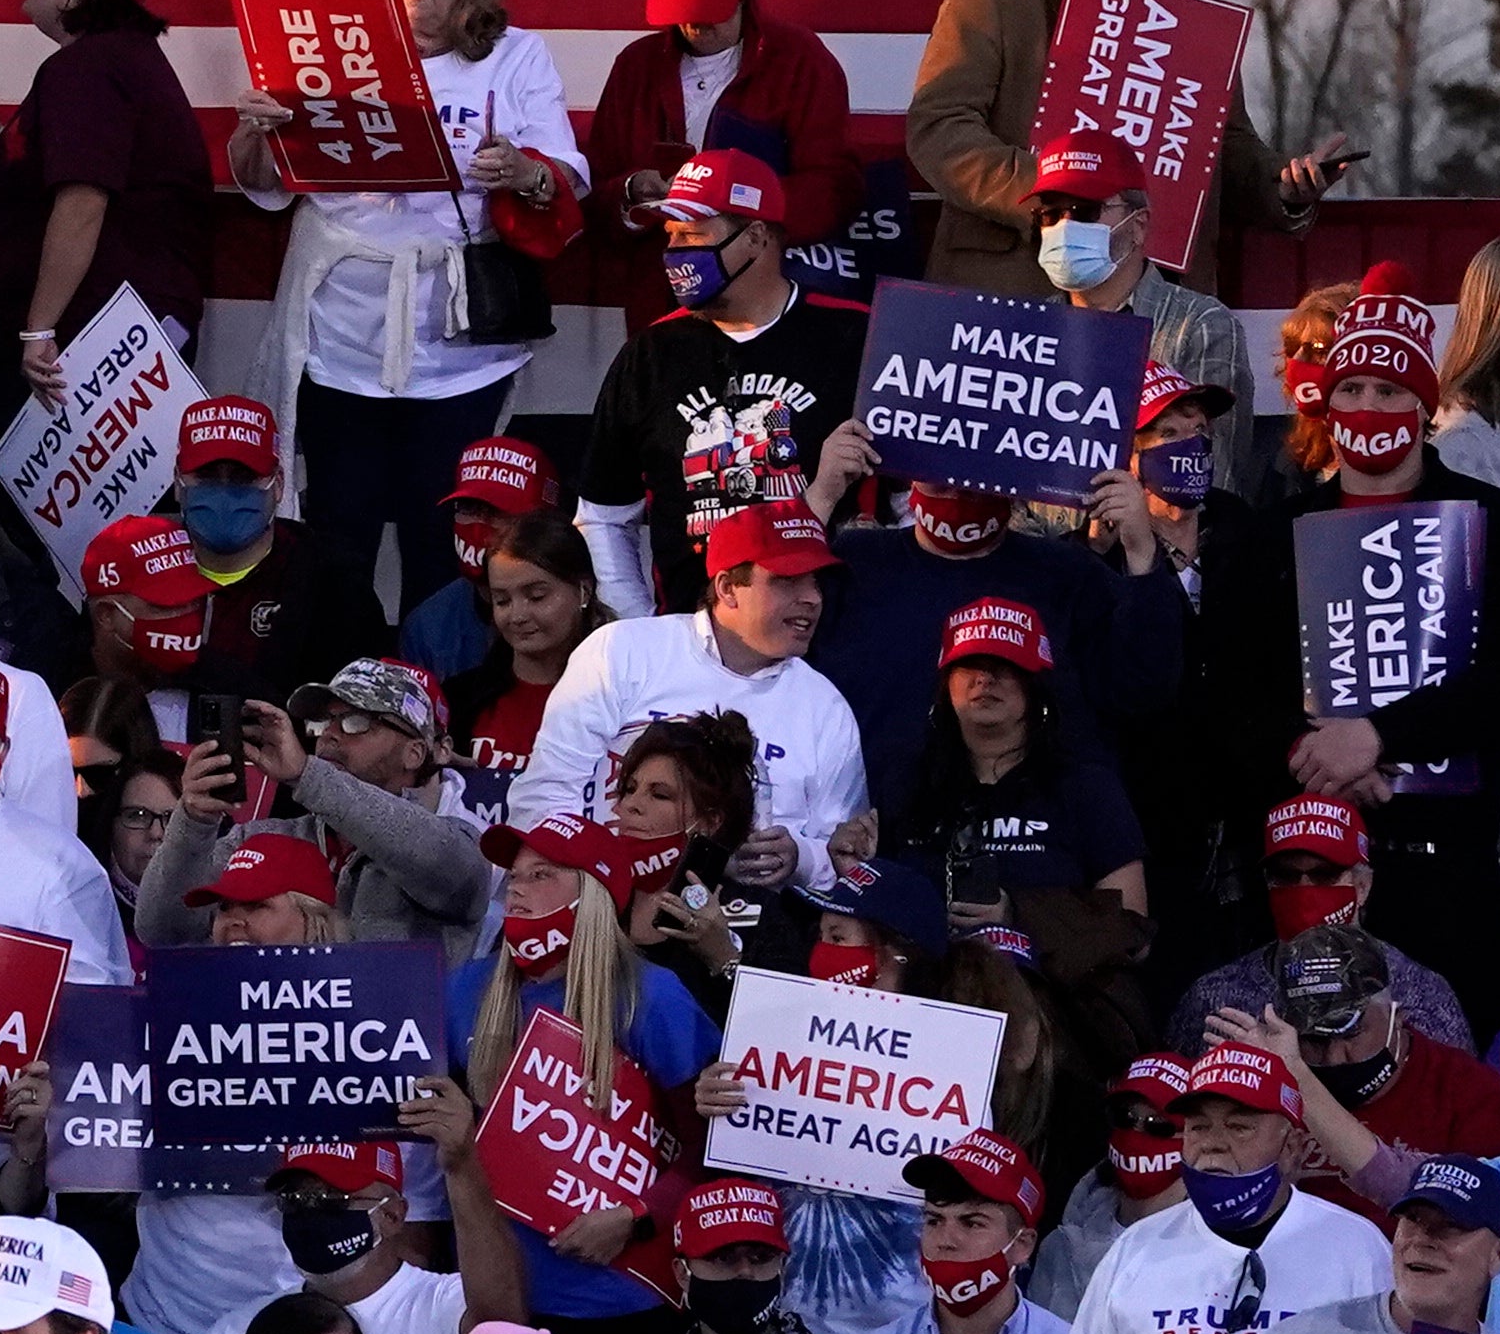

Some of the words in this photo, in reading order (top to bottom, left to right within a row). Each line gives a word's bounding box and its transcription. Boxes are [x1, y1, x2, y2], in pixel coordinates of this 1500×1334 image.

[279, 8, 346, 129] MORE
[330, 13, 403, 160] YEARS!
[410, 72, 426, 101] 2020
[1154, 75, 1203, 181] MAKE
[317, 138, 351, 164] 4
[951, 323, 1059, 367] MAKE
[1335, 344, 1408, 373] 2020
[73, 324, 149, 416] GREAT
[675, 386, 717, 423] ALL
[727, 372, 818, 413] ABOARD
[871, 354, 1121, 431] AMERICA
[13, 407, 74, 498] AGAIN
[35, 350, 169, 528] AMERICA
[866, 407, 990, 452] GREAT
[996, 427, 1118, 470] AGAIN
[1332, 422, 1412, 456] MAGA
[93, 436, 158, 518] MAKE
[693, 497, 721, 508] THE
[915, 504, 1000, 543] MAGA
[97, 563, 121, 588] 45
[1413, 517, 1447, 639] AGAIN
[1361, 520, 1409, 708] ERICA
[1328, 598, 1357, 708] MAKE
[1267, 808, 1299, 827] MAKE
[1299, 802, 1352, 826] AMERICA
[1271, 824, 1305, 842] GREAT
[1307, 821, 1344, 840] AGAIN
[239, 978, 353, 1011] MAKE
[165, 1019, 432, 1063] AMERICA
[808, 1016, 912, 1059] MAKE
[166, 1077, 300, 1108] GREAT
[307, 1076, 433, 1105] AGAIN
[733, 1047, 970, 1125] AMERICA
[727, 1103, 842, 1145] GREAT
[1420, 1162, 1483, 1189] Trump
[1430, 1173, 1463, 1187] 2020
[935, 1270, 1001, 1303] AGA
